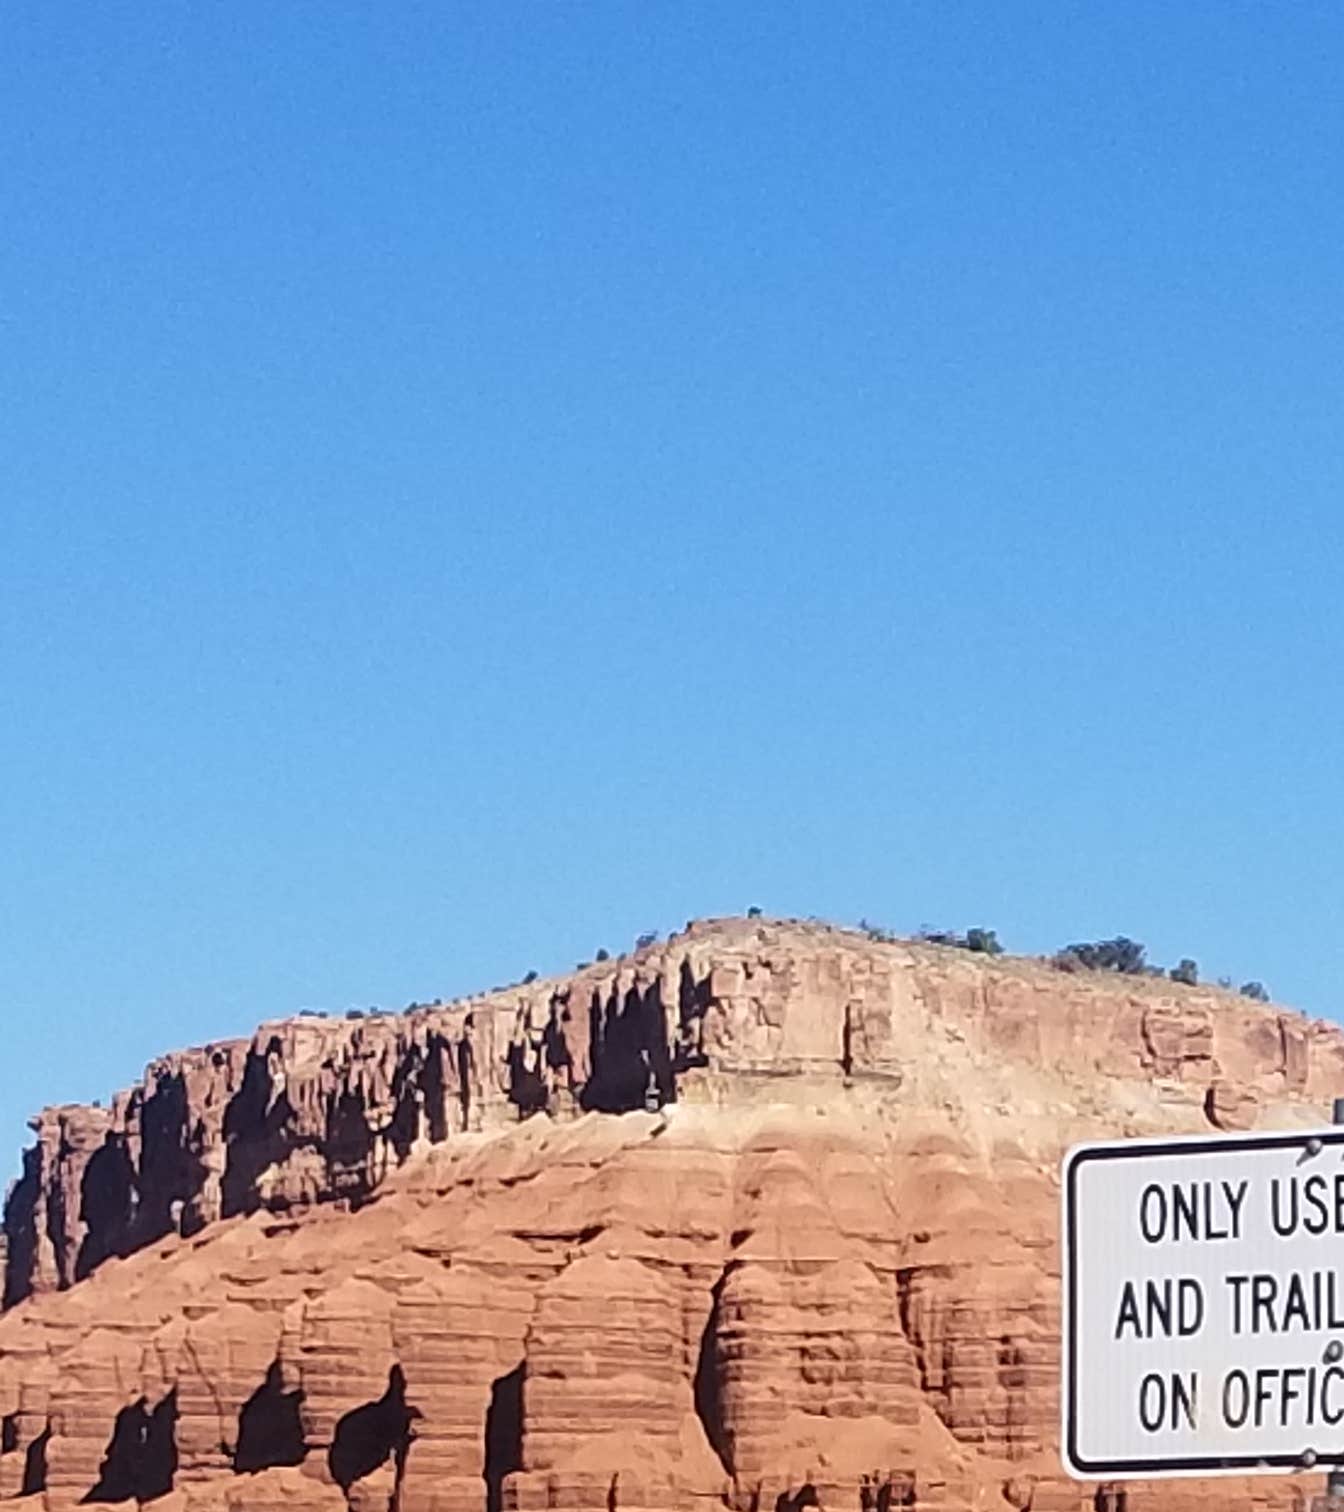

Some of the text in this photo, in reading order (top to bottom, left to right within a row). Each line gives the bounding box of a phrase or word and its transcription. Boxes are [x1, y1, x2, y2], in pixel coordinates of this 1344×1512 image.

[1139, 1180, 1248, 1244] ONLY
[1115, 1278, 1204, 1340] AND
[1138, 1373, 1197, 1433] ON
